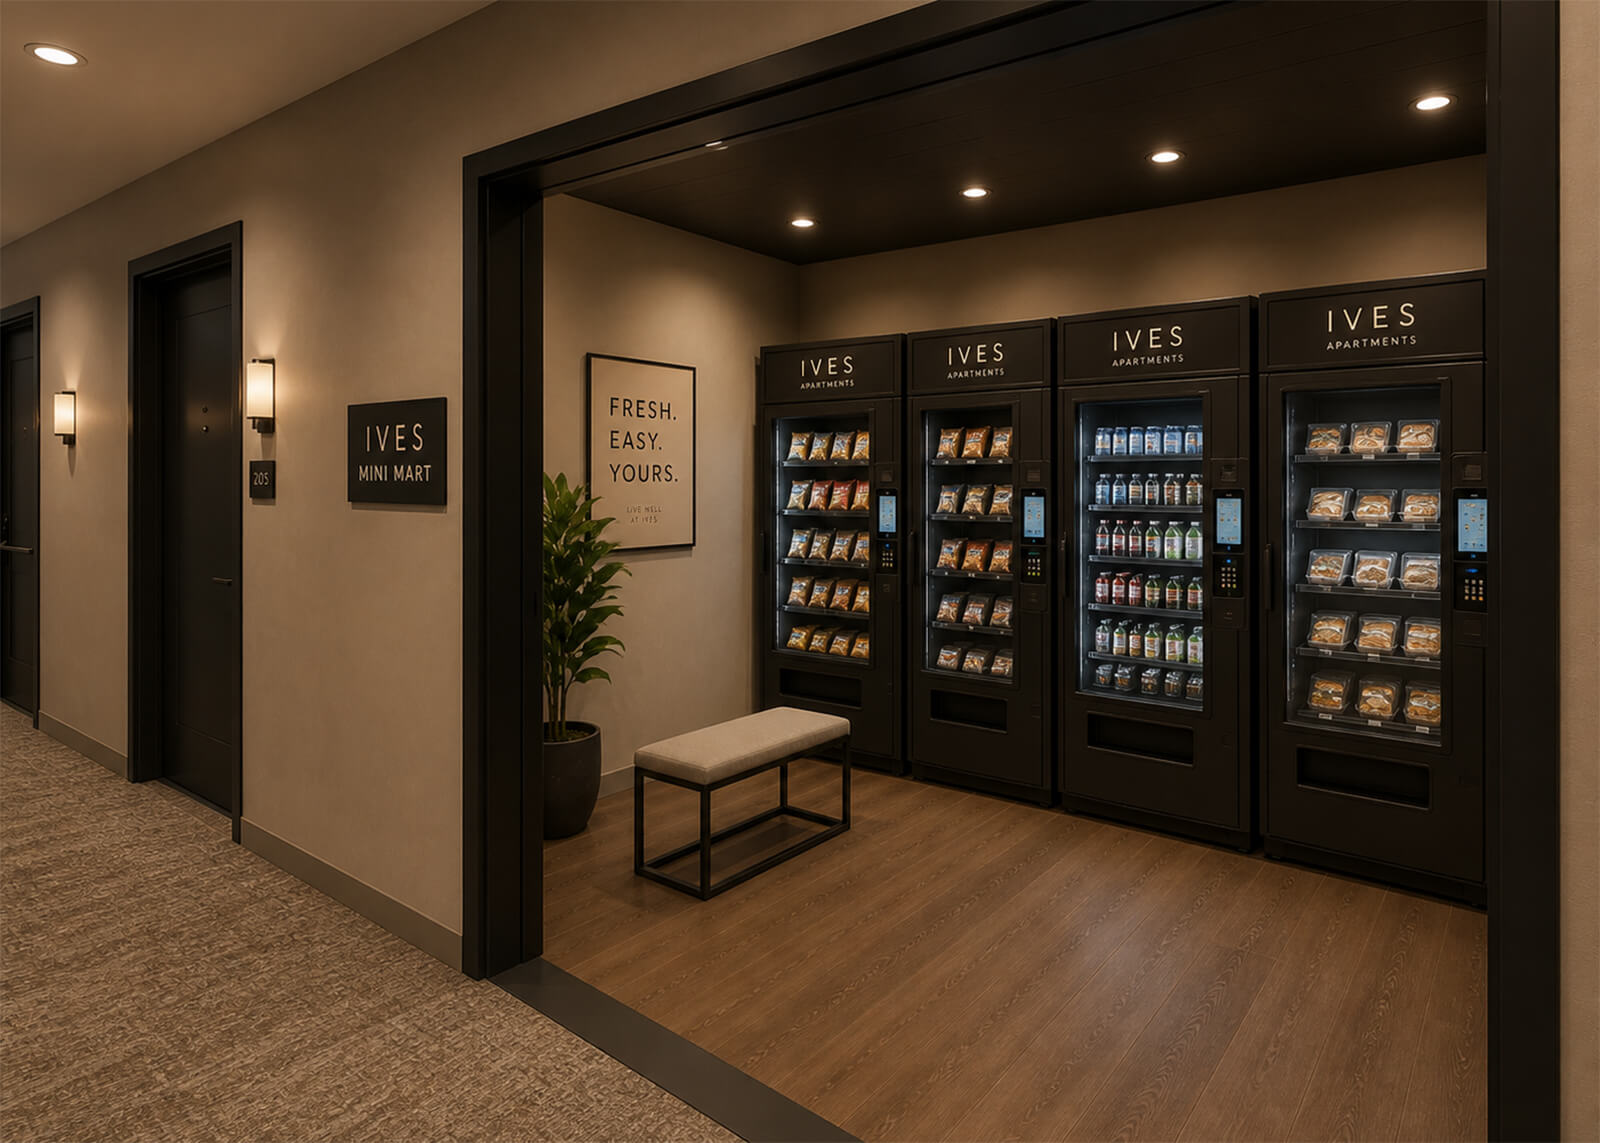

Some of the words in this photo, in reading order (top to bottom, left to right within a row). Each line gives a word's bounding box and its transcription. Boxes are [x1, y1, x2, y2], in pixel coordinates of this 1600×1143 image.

[1329, 302, 1415, 333] IVES
[1113, 325, 1183, 352] IVES
[1326, 335, 1417, 351] APARTMENTS
[949, 342, 1004, 366] IVES
[1112, 354, 1184, 367] APARTMENTS
[801, 355, 853, 377] IVES
[948, 368, 1005, 380] APARTMENTS
[800, 379, 855, 390] APARTMENTS
[609, 397, 677, 421] FRESH.
[366, 423, 423, 452] IVES
[610, 430, 662, 450] EASY.
[253, 472, 269, 486] 205
[358, 464, 388, 482] MINI
[393, 464, 432, 482] MART
[609, 463, 678, 483] YOURS.
